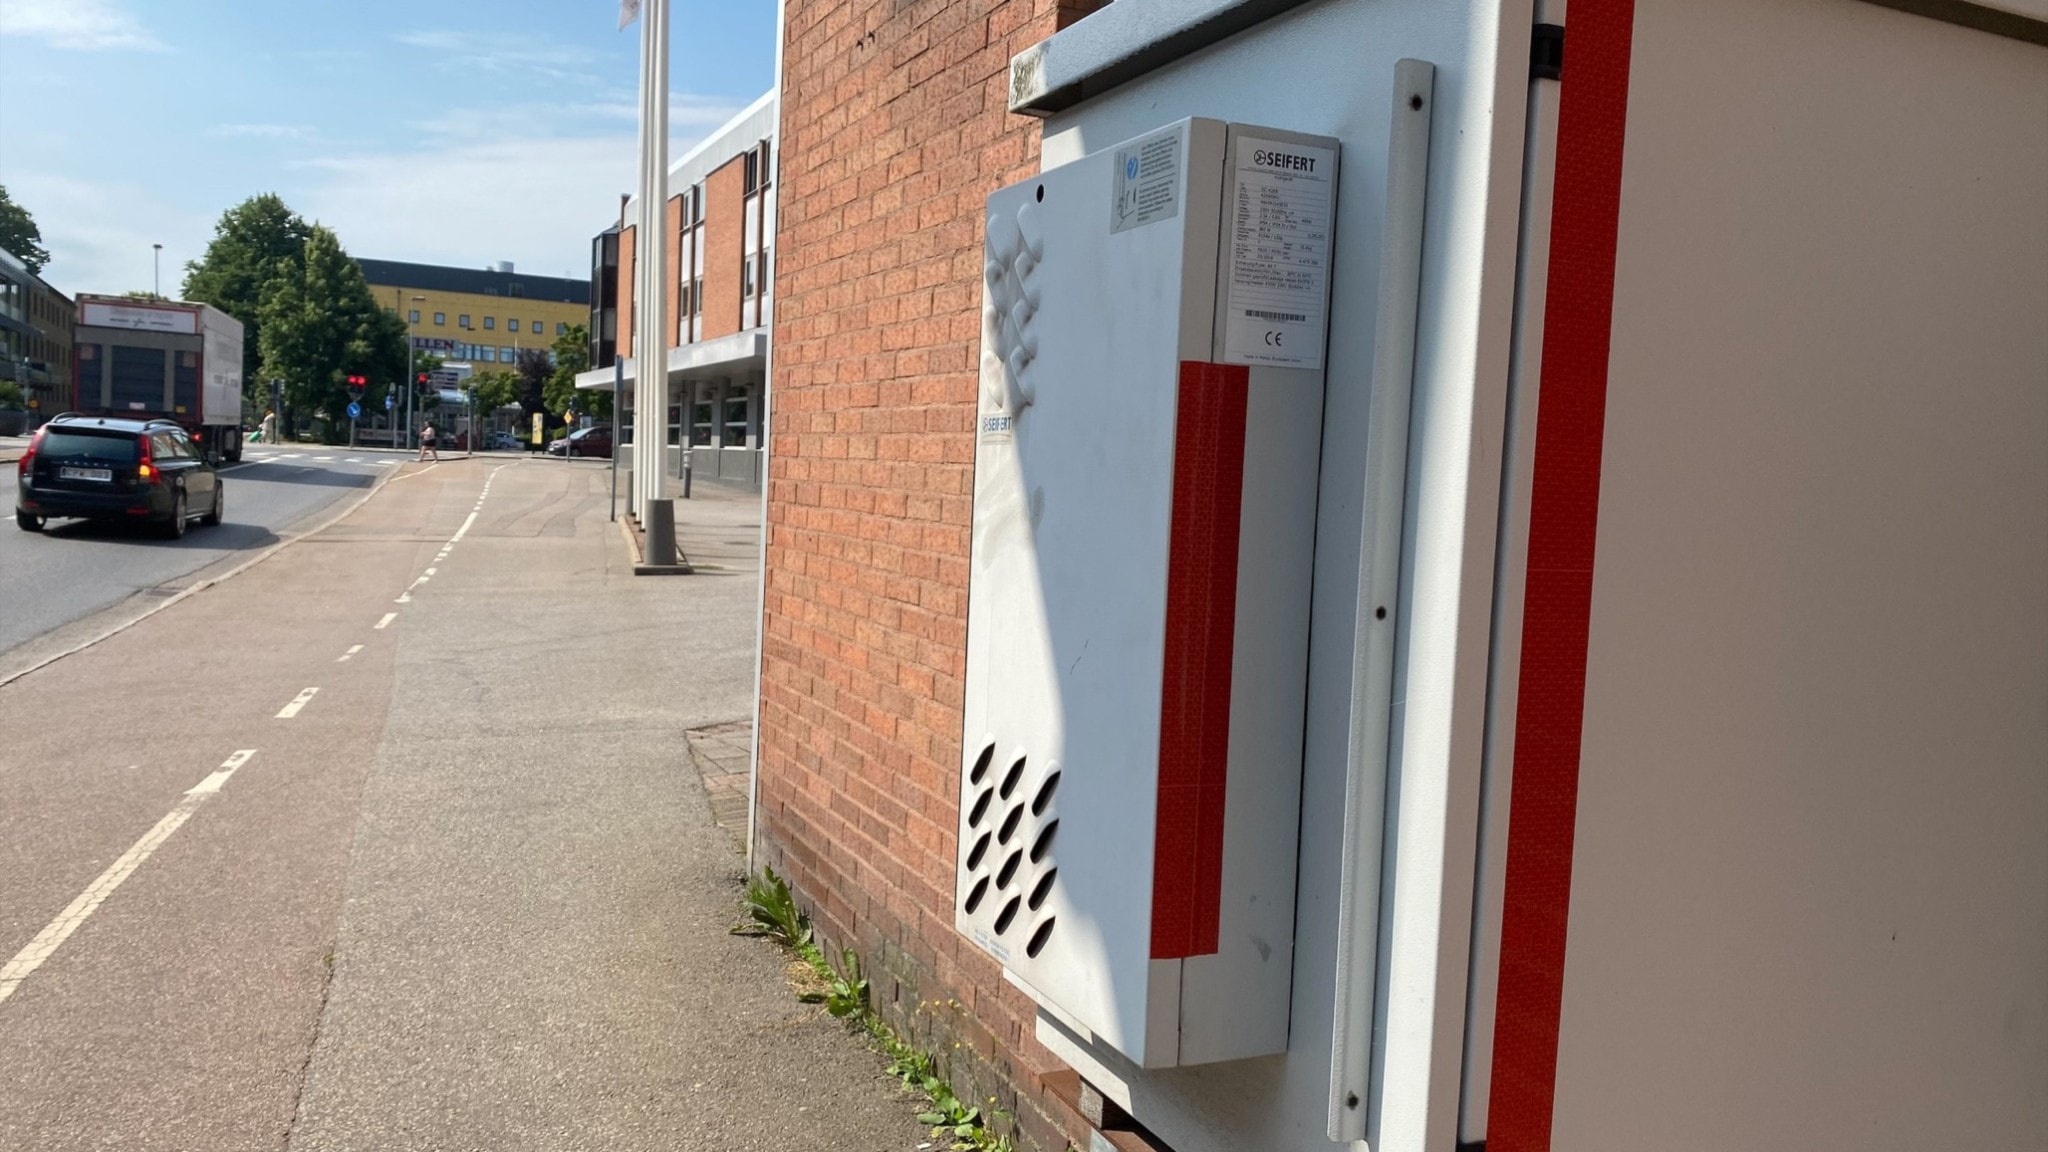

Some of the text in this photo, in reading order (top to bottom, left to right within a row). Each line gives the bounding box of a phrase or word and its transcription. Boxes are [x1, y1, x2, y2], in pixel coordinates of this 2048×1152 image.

[1267, 151, 1316, 172] SEIFERT
[1265, 331, 1282, 347] CE
[988, 416, 1012, 431] SEIFERT
